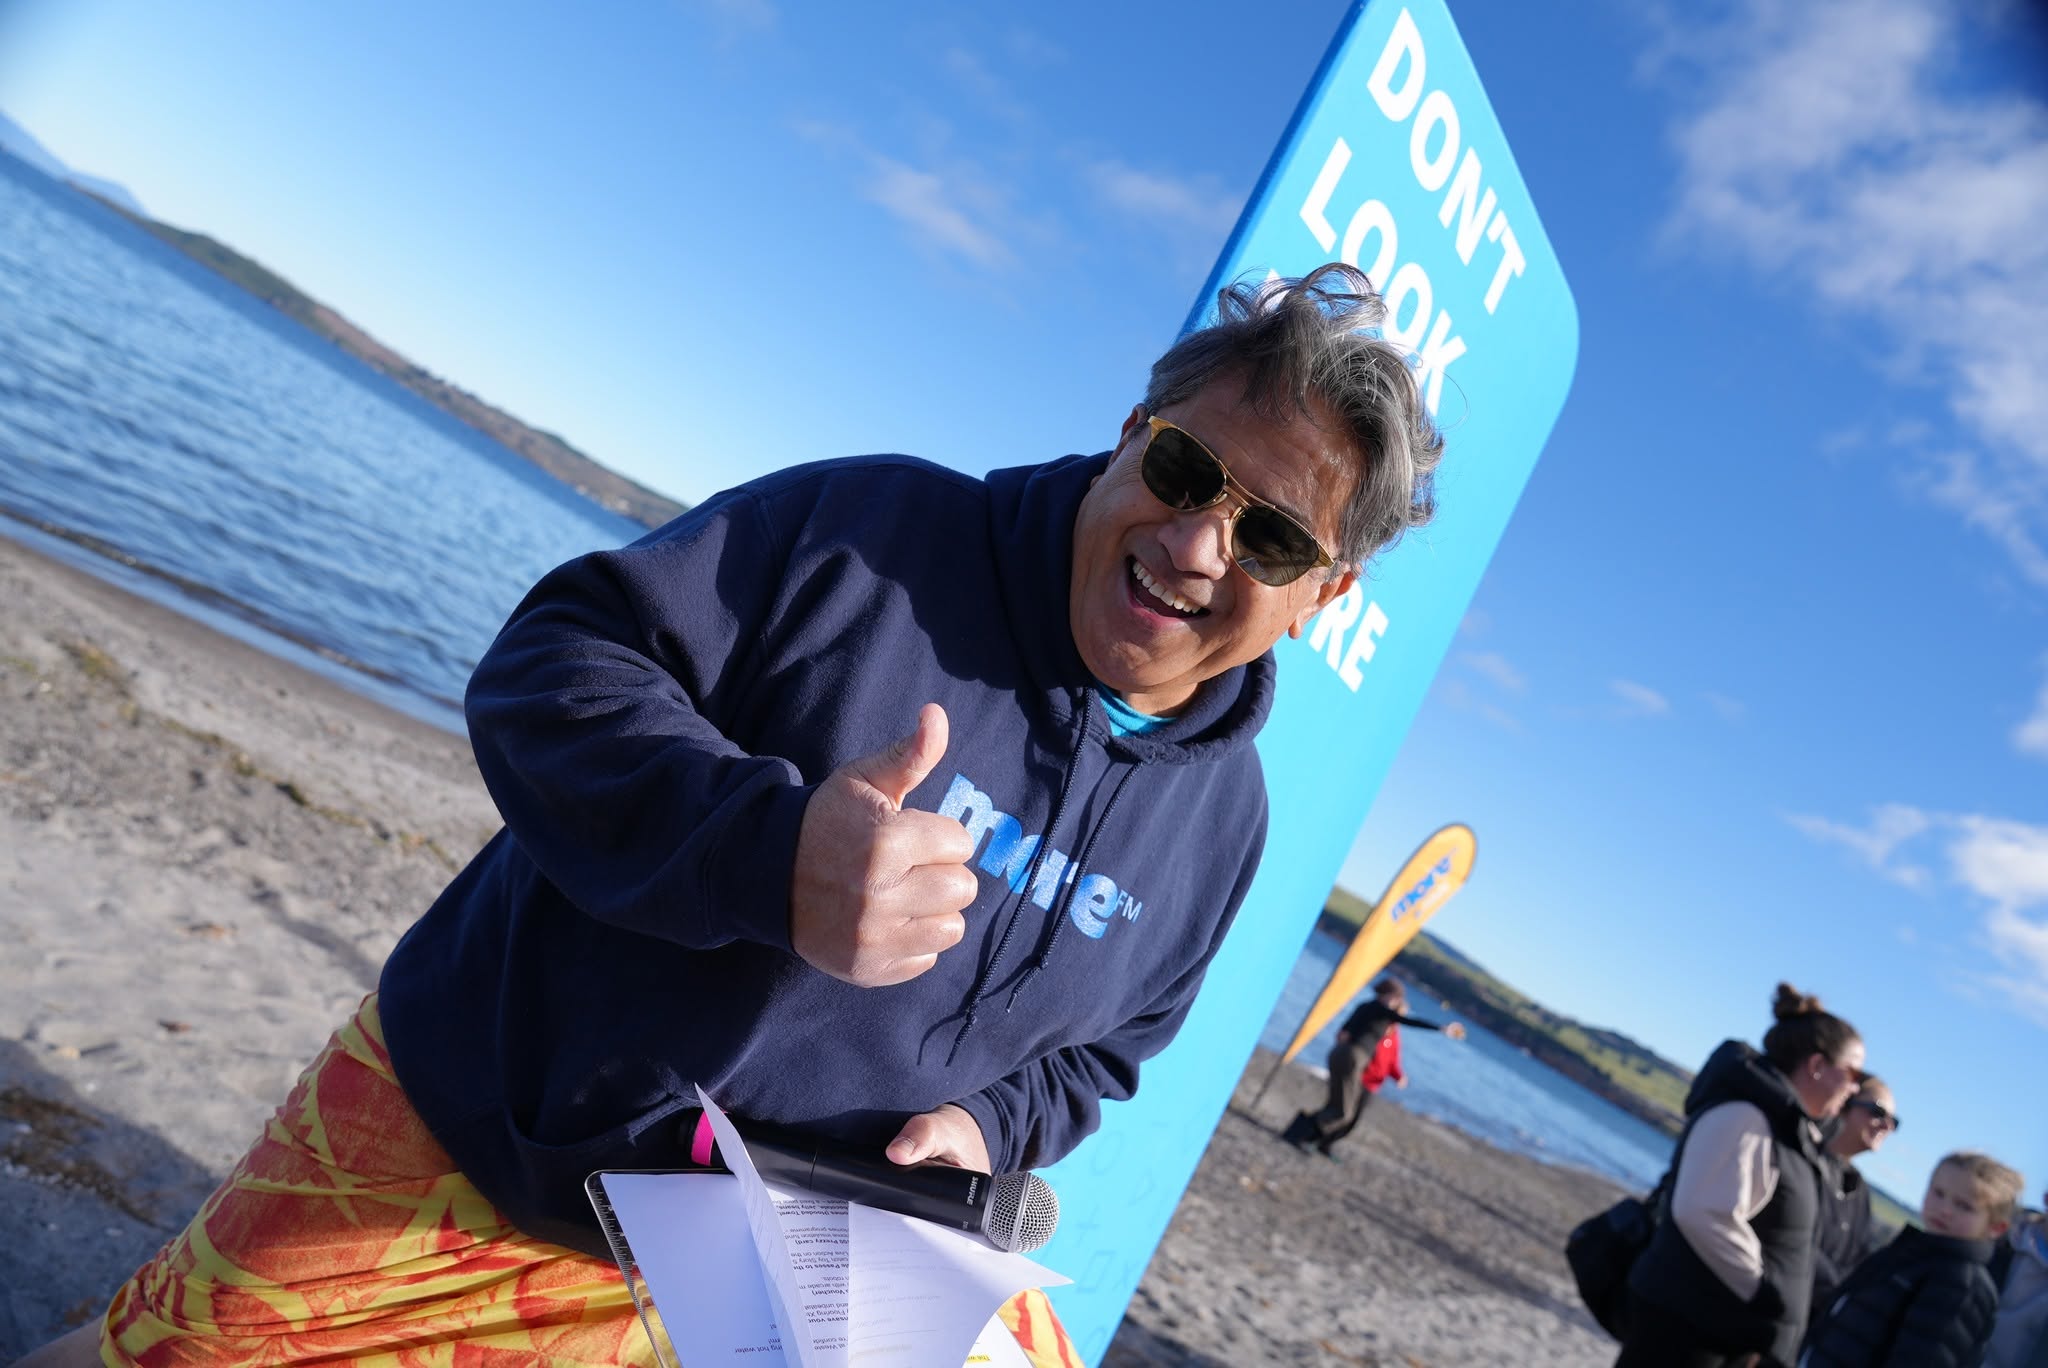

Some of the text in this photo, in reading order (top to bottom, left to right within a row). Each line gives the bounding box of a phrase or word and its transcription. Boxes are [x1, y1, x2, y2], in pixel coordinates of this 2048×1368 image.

[1367, 8, 1527, 315] DON'T
[1299, 136, 1467, 417] LOOK
[967, 1175, 979, 1206] SHURE
[811, 1289, 846, 1297] Voucher)
[817, 1309, 846, 1317] Flooring
